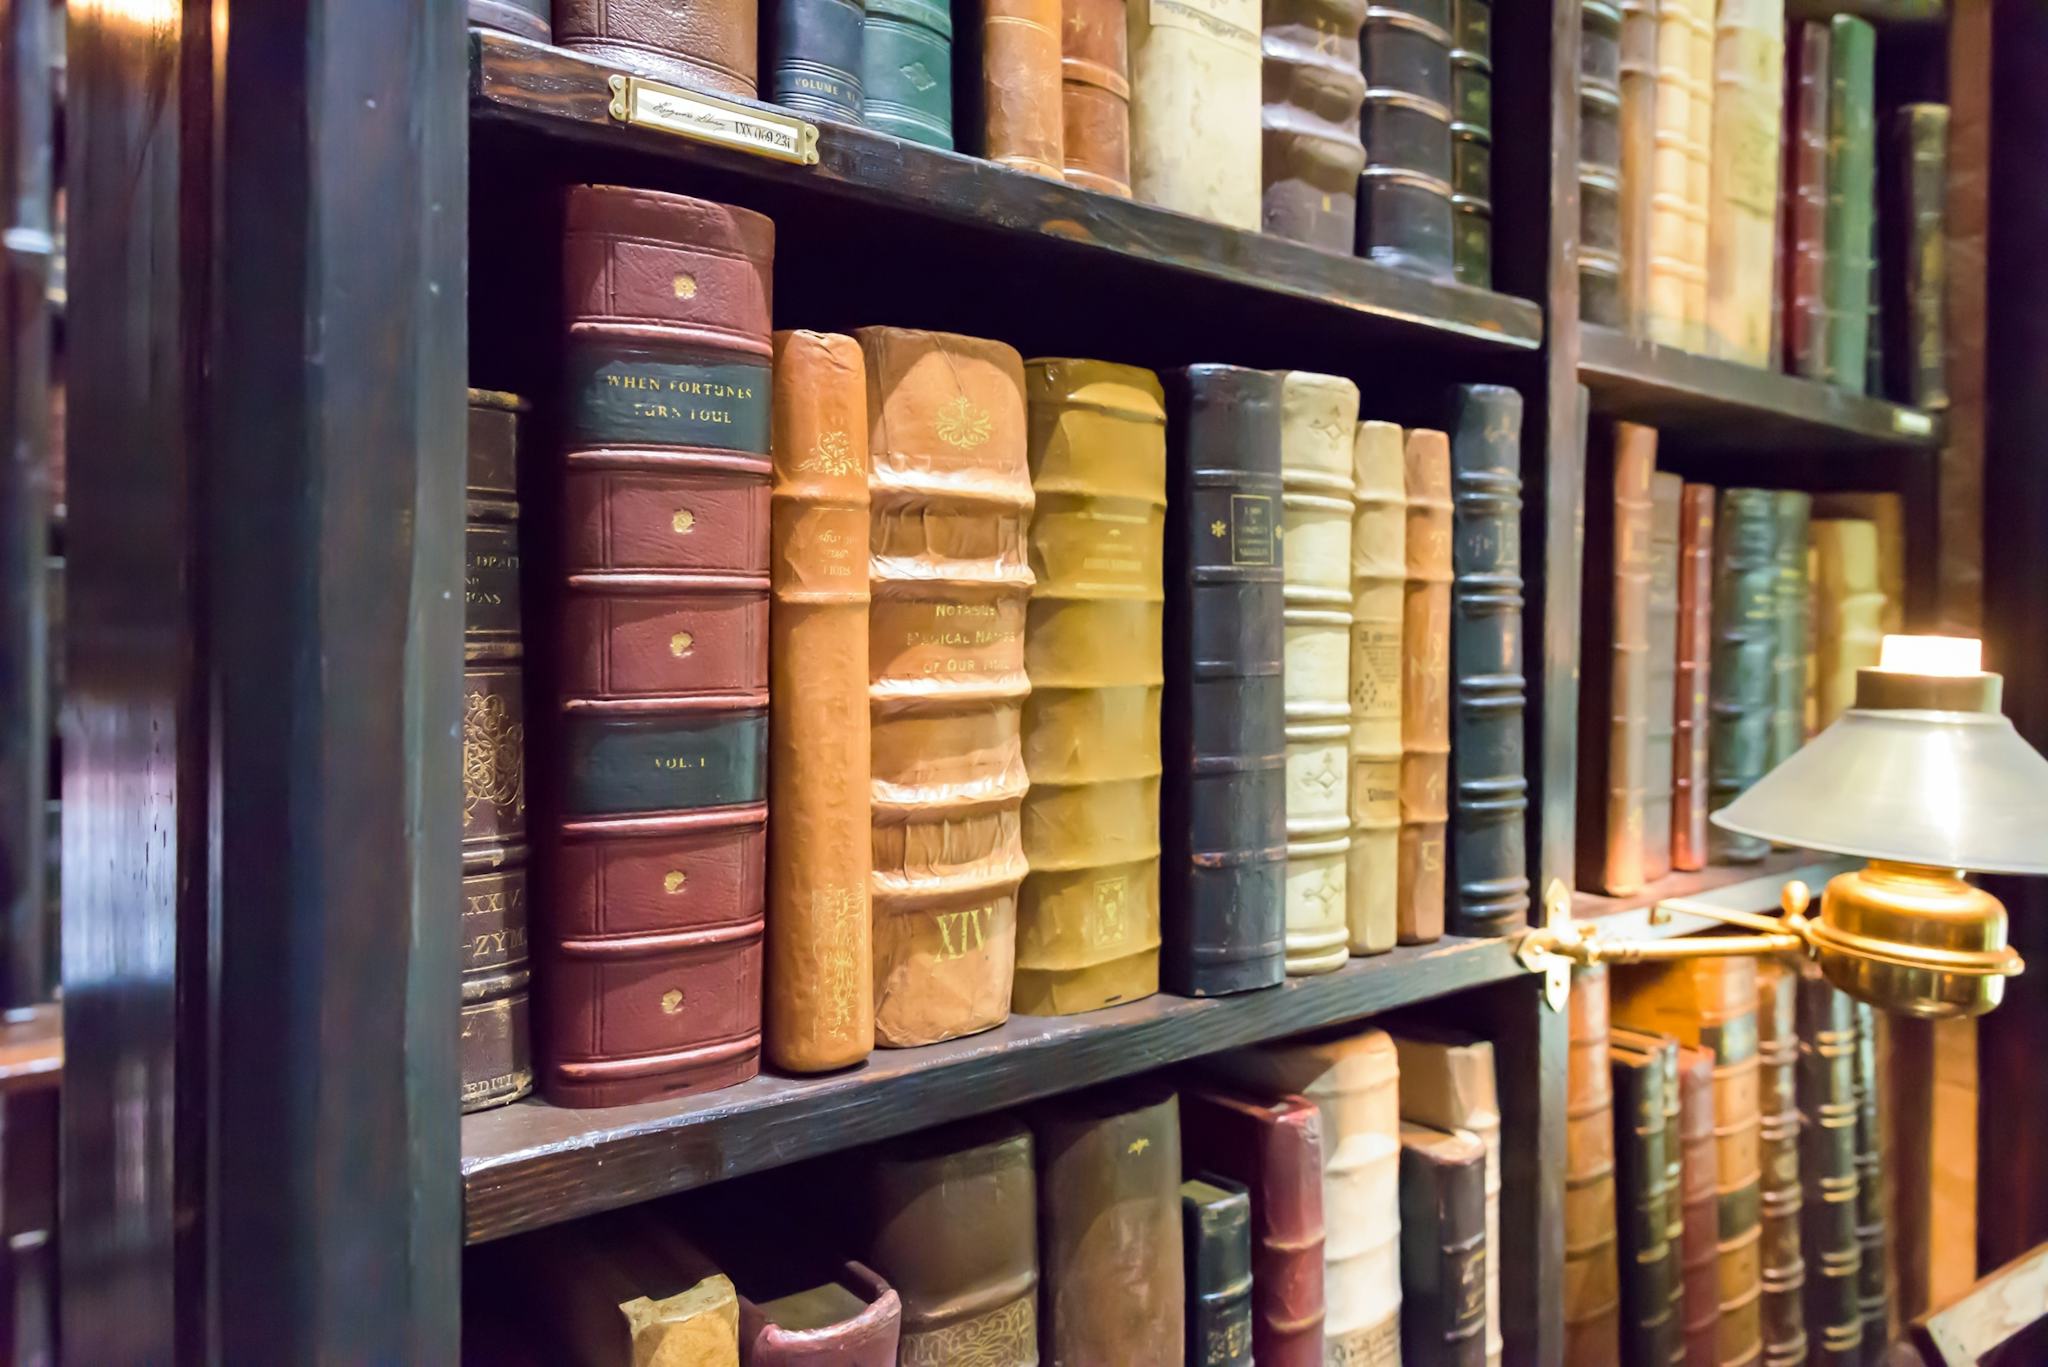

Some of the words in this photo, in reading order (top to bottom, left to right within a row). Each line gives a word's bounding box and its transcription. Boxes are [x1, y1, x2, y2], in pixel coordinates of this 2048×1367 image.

[795, 78, 838, 95] VOLUME
[607, 375, 661, 390] WHEN
[670, 380, 752, 399] FORTUNES
[906, 631, 971, 646] ICAL
[975, 631, 1015, 643] NAES
[946, 658, 976, 673] OUR
[934, 906, 993, 963] XIV
